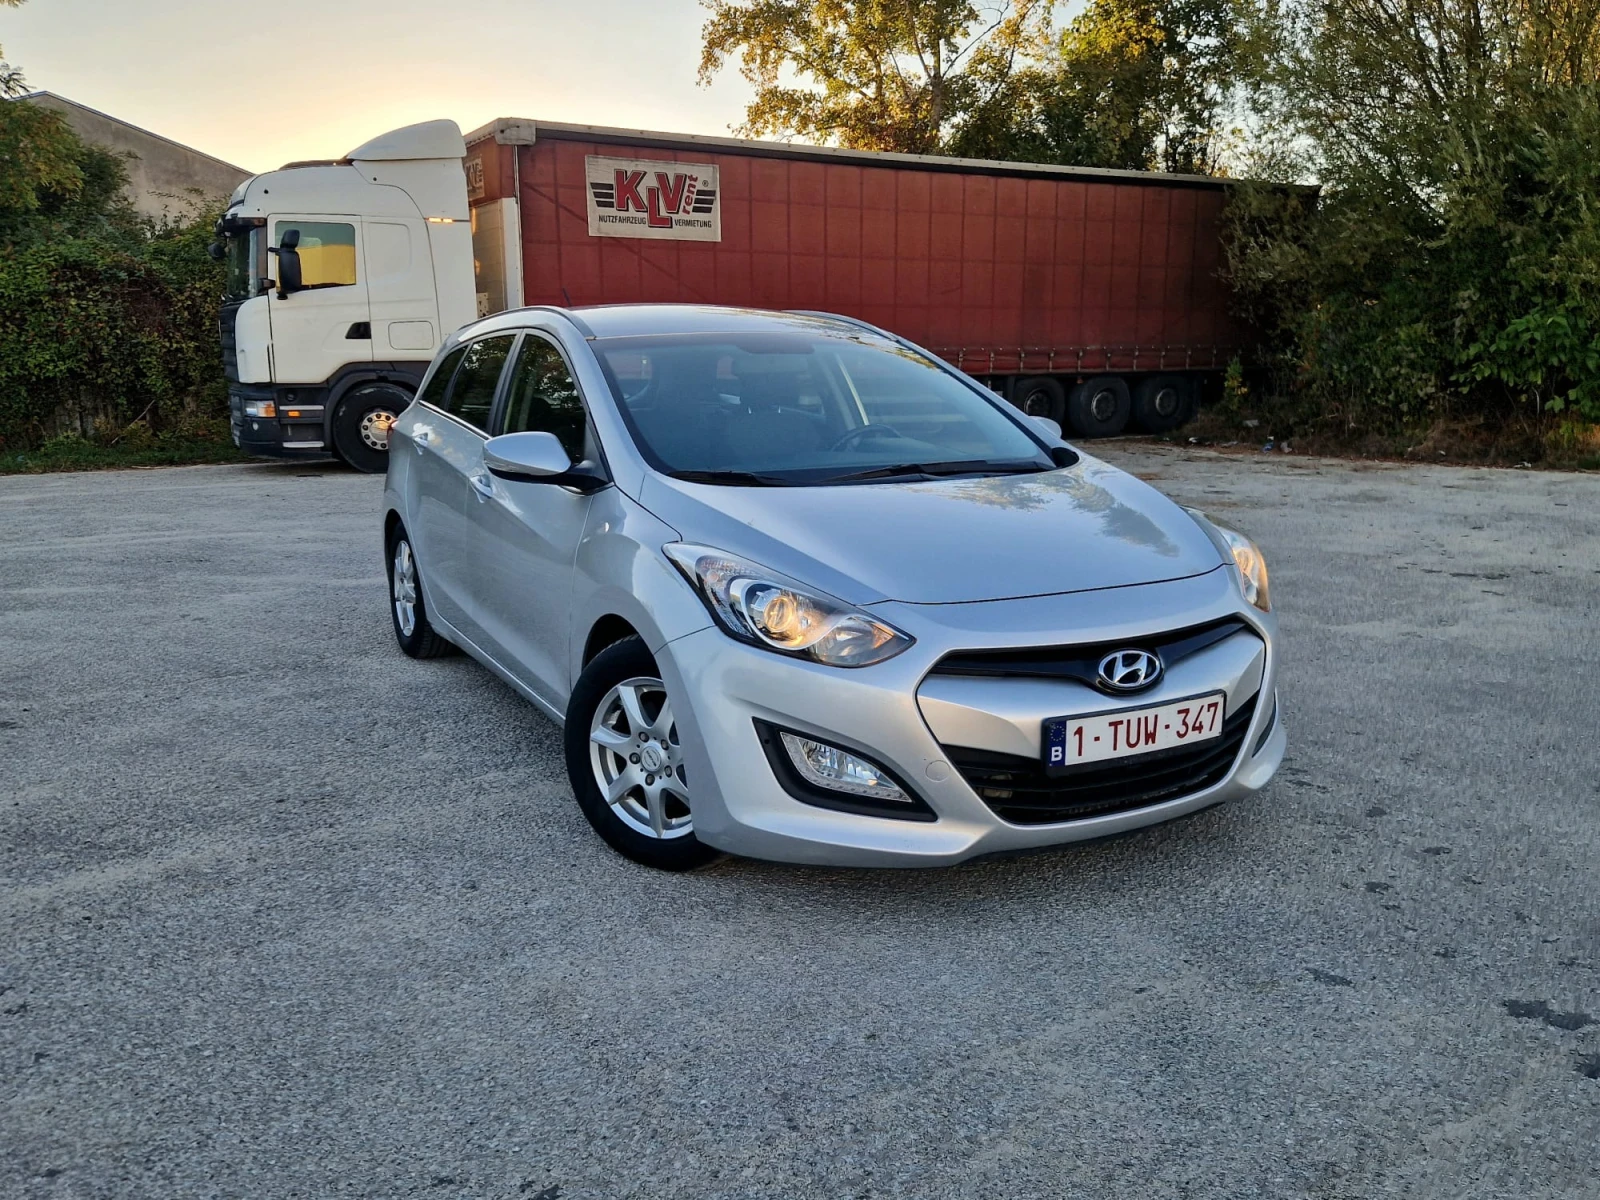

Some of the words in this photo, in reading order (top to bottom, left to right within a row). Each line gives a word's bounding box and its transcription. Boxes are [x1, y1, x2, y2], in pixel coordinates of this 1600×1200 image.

[614, 168, 687, 228] KLV
[682, 174, 698, 215] rent
[598, 215, 647, 225] NUTZFAHRZEUG
[674, 219, 712, 228] VERMIETUNG
[1051, 746, 1063, 762] B
[1073, 702, 1219, 757] 1-TUW-347
